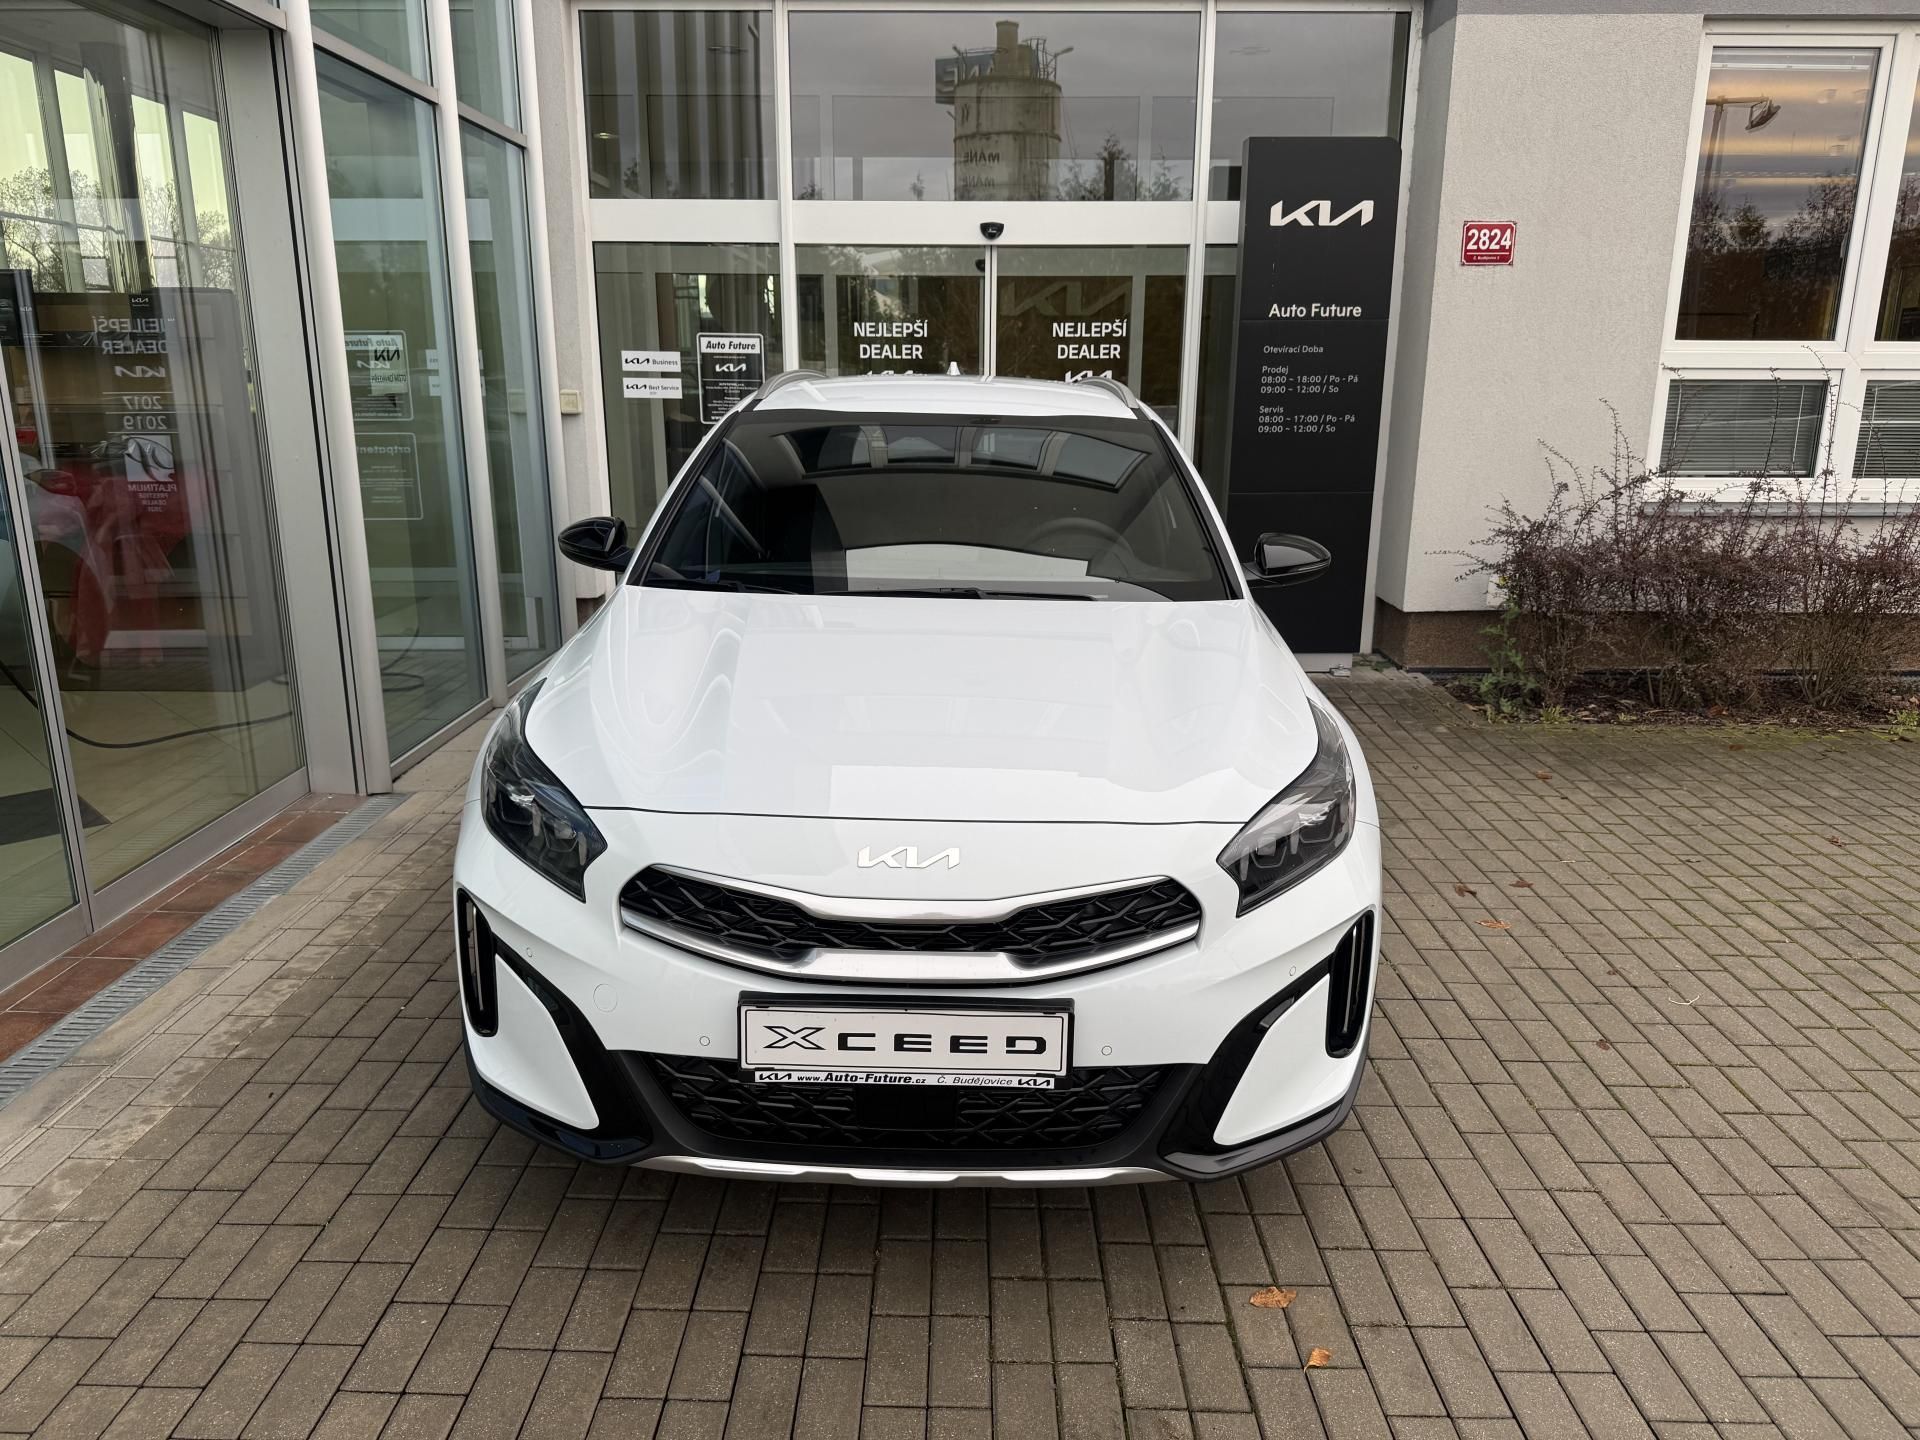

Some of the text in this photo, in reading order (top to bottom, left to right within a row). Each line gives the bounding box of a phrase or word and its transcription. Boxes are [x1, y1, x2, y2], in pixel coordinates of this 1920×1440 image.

[1270, 200, 1374, 226] KIA
[1466, 228, 1511, 250] 2824
[1269, 303, 1362, 317] Auto Future
[853, 319, 928, 338] NEJLEPŠÍ
[1052, 318, 1128, 338] NEJLEPŠÍ
[705, 340, 756, 350] Auto Future
[1302, 345, 1324, 353] Doba
[859, 344, 923, 360] DEALER
[1057, 344, 1121, 360] DEALER
[625, 357, 650, 365] KIA
[715, 363, 747, 372] KIA
[1262, 365, 1289, 375] Prodej
[1261, 375, 1287, 384] 08:00
[1296, 375, 1322, 383] 18:00
[1329, 375, 1340, 383] Po
[1260, 385, 1286, 394] 09:00
[1296, 385, 1321, 393] 12:00
[1328, 385, 1339, 393] So
[1259, 405, 1284, 414] Servis
[1258, 415, 1284, 423] 08:00
[1294, 415, 1318, 423] 17:00
[1326, 414, 1337, 423] Po
[1257, 425, 1283, 433] 09:00
[1293, 425, 1318, 433] 12:00
[1325, 424, 1336, 433] So
[857, 846, 960, 869] KIA
[762, 1025, 1047, 1055] XCEED
[758, 1073, 792, 1081] KIA
[797, 1072, 927, 1084] www.Auto-Future.cz
[952, 1076, 1013, 1086] Budějovice
[1018, 1078, 1051, 1087] KIA
